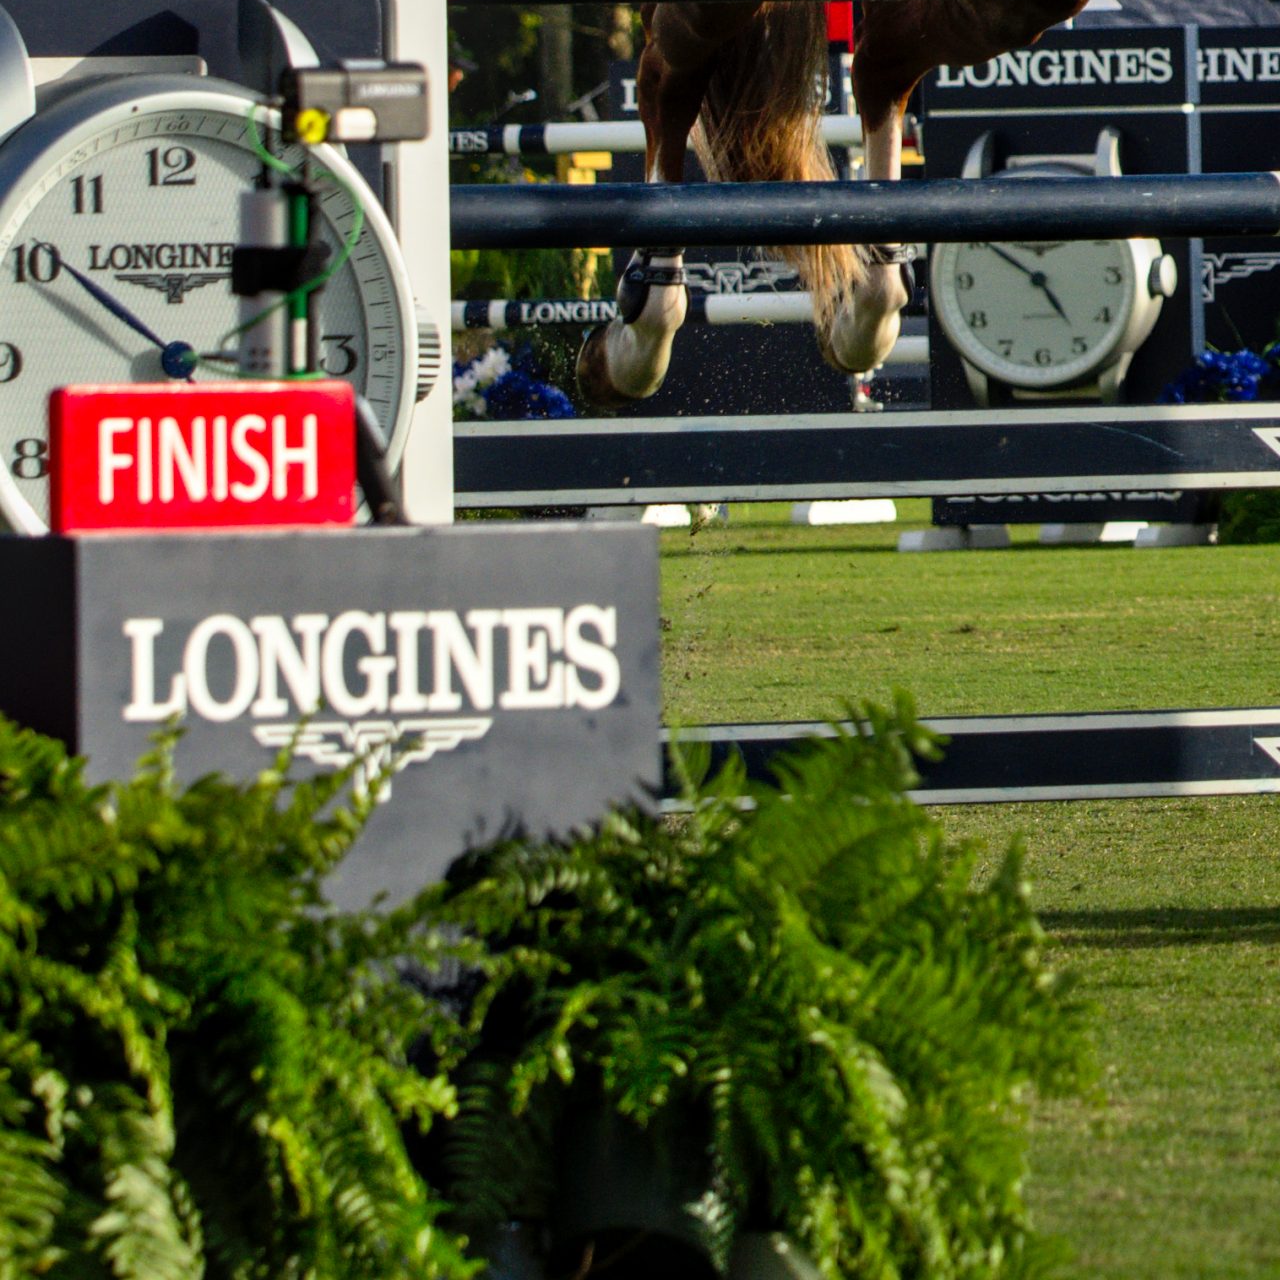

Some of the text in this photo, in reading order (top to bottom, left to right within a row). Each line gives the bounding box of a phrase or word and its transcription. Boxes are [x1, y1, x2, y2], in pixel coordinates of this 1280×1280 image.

[936, 47, 1173, 88] LONGINES
[145, 146, 197, 187] 12
[70, 174, 104, 214] 11
[13, 241, 61, 284] 10
[520, 299, 622, 323] LONGIN
[319, 334, 358, 376] 3
[11, 438, 51, 480] 8
[98, 414, 319, 504] FINISH
[123, 604, 621, 722] LONGINES
